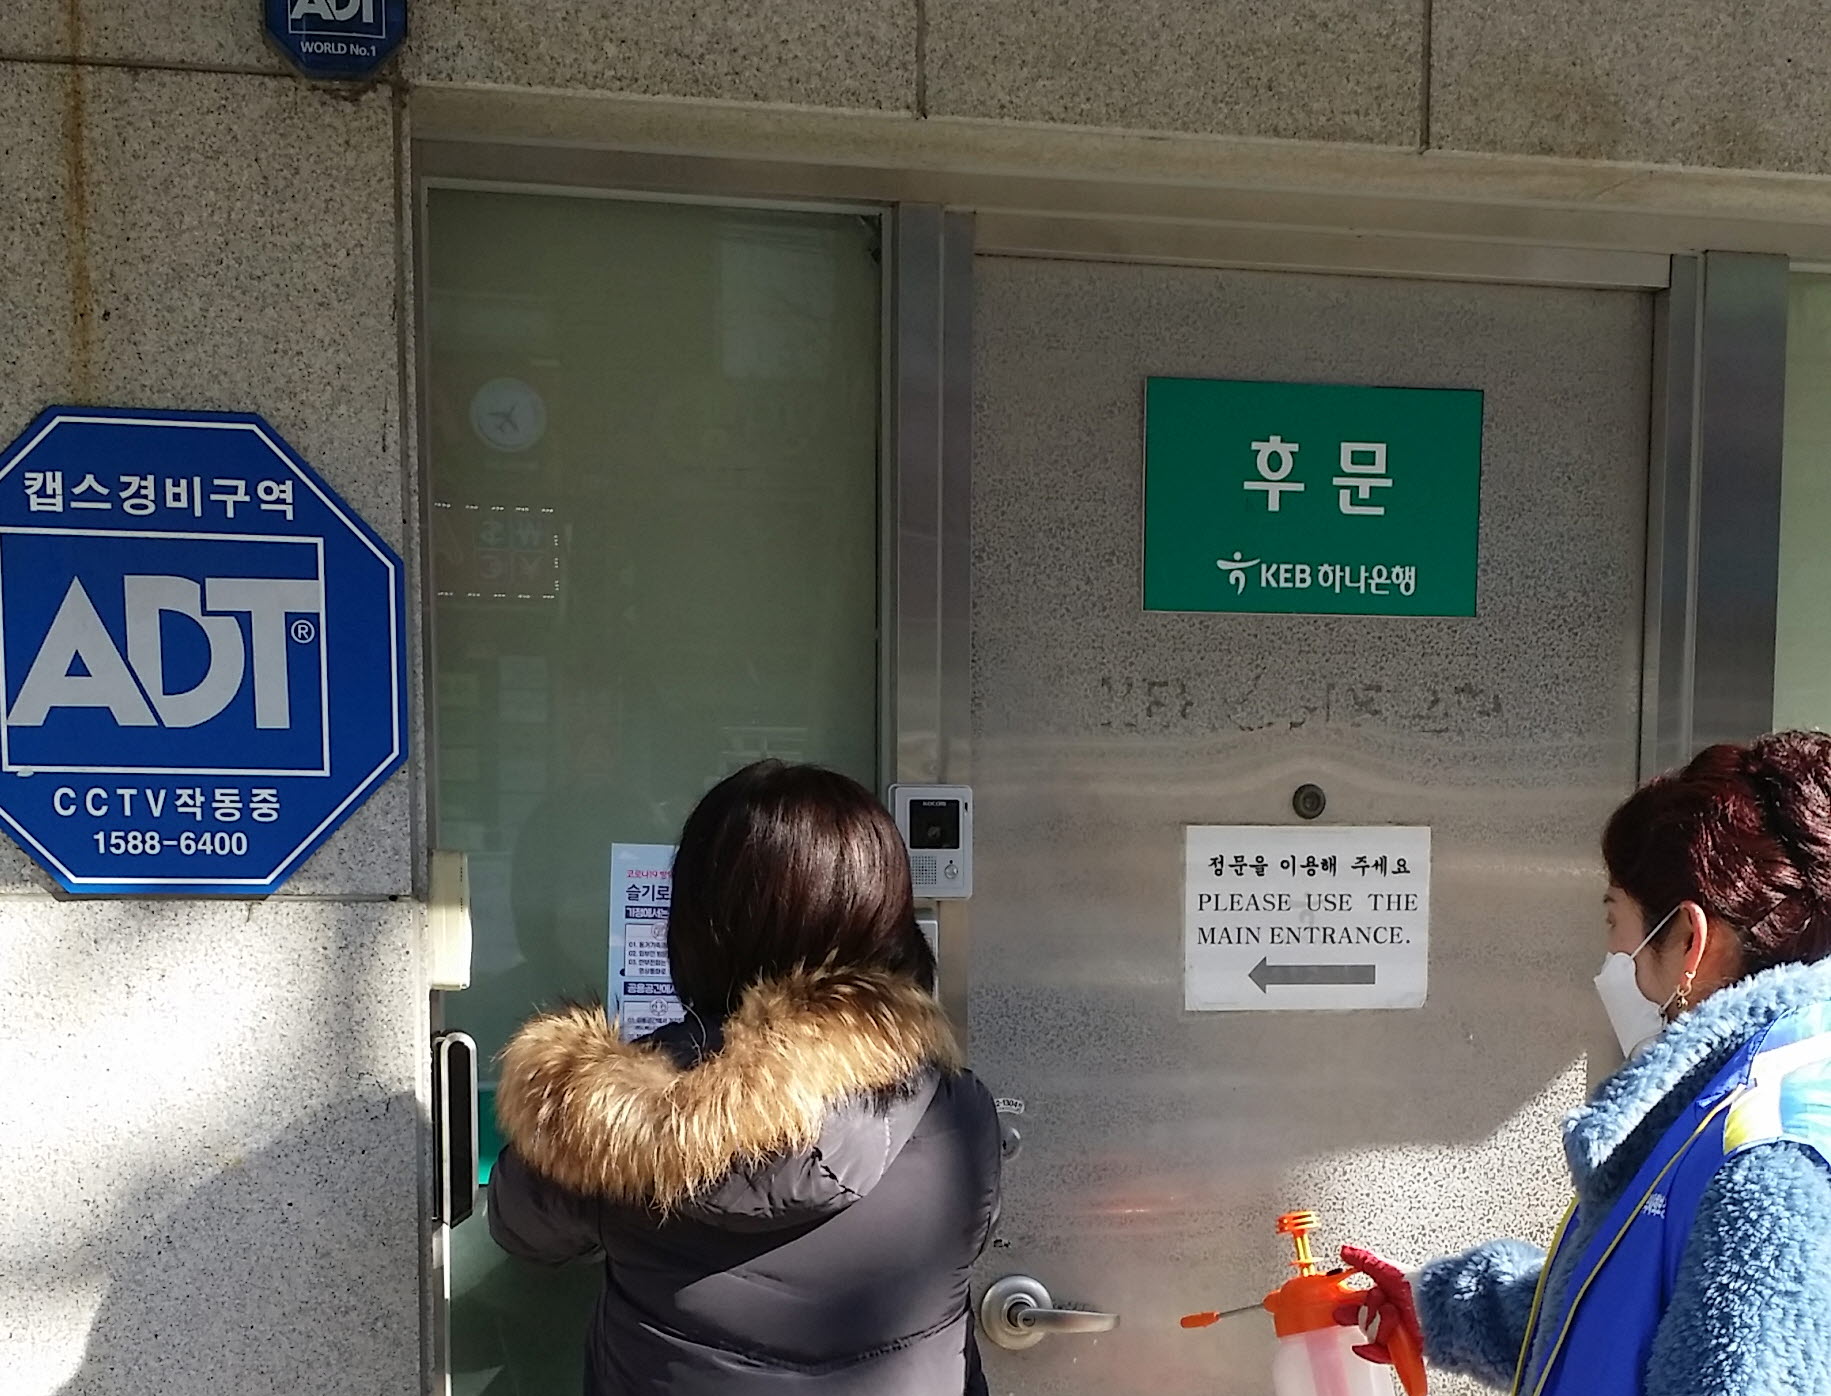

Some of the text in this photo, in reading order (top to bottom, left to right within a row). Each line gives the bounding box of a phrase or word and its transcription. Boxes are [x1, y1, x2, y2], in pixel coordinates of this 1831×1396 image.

[300, 41, 377, 57] WORLD No.1
[23, 470, 294, 521] 캡스경비구역
[6, 574, 321, 730] ADT
[53, 786, 281, 822] CCTV작동중
[93, 830, 249, 857] 1588-6400
[1207, 853, 1411, 878] 정문을 이용해 주세요
[1197, 893, 1418, 912] PLEASE USE THE
[1197, 926, 1412, 945] MAIN ENTRANCE.
